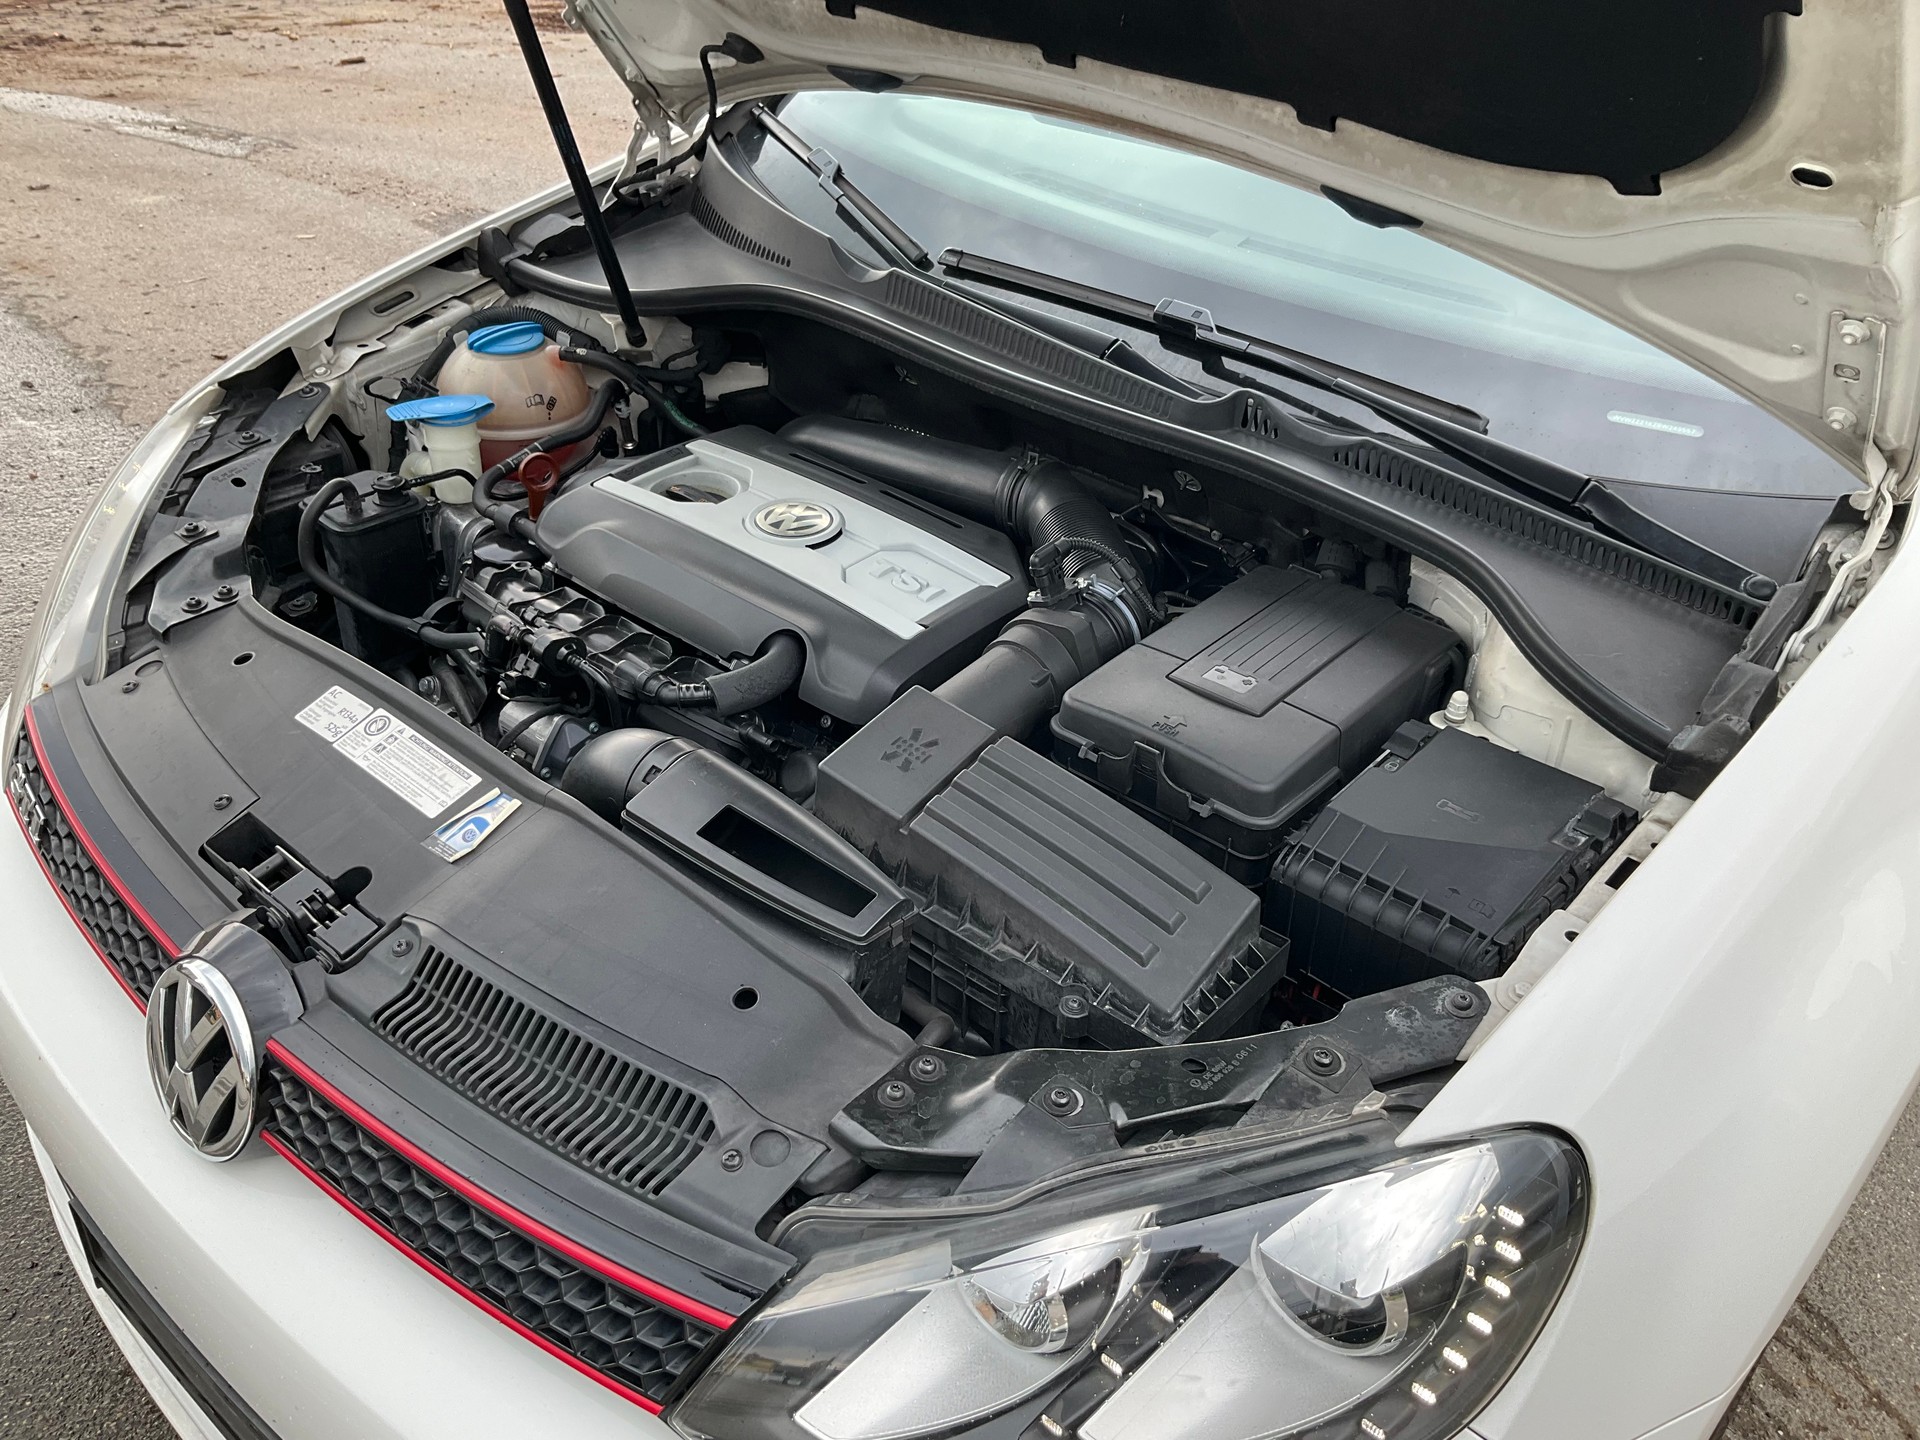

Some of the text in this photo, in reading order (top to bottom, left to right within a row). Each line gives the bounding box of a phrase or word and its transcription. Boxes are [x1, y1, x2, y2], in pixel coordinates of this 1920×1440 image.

[869, 558, 947, 602] TSI
[328, 689, 343, 699] AC
[338, 708, 358, 724] R134a
[324, 722, 343, 738] 525g
[1152, 721, 1180, 737] PUSH
